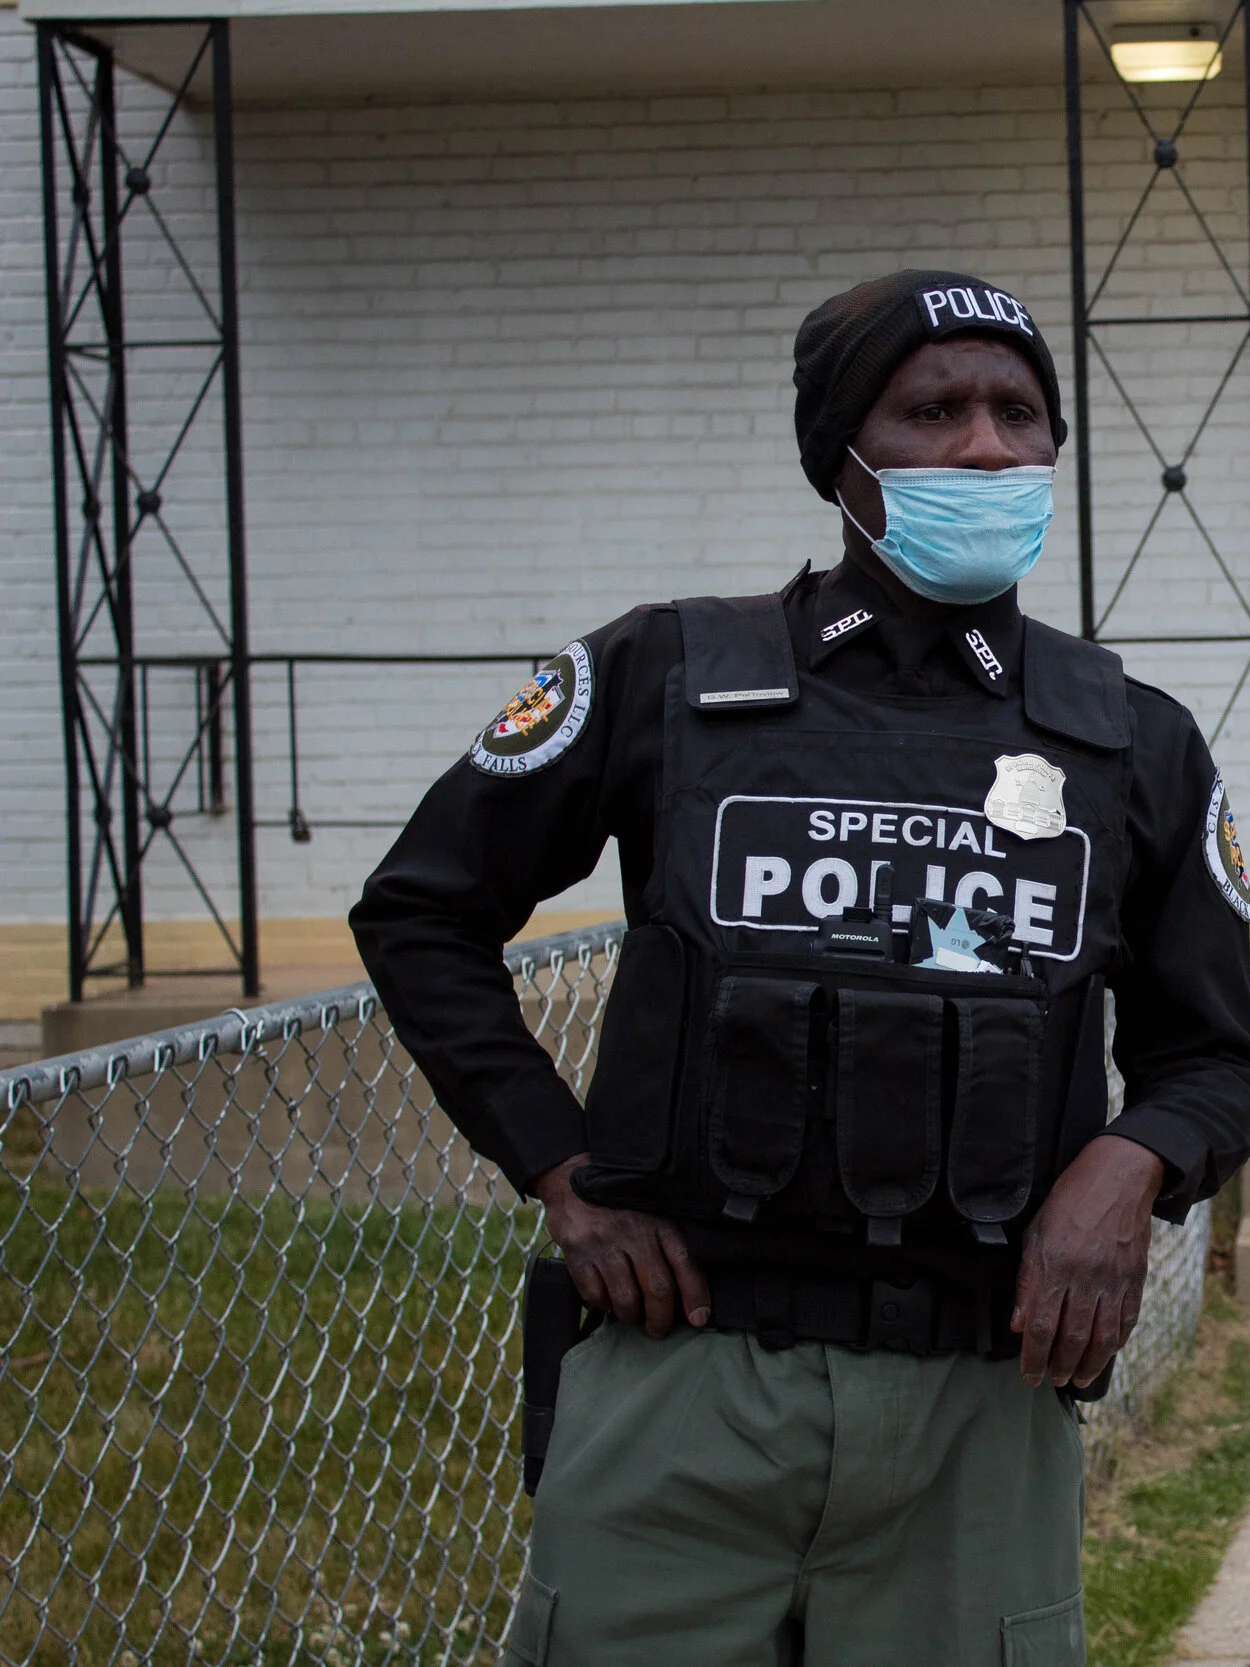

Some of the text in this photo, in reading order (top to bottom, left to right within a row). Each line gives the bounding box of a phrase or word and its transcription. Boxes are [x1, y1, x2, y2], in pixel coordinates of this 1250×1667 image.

[922, 287, 1033, 336] POLICE
[560, 703, 586, 739] LLC
[482, 753, 527, 772] FALLS
[808, 810, 1007, 859] SPECIAL
[831, 933, 880, 943] MOTOROLA
